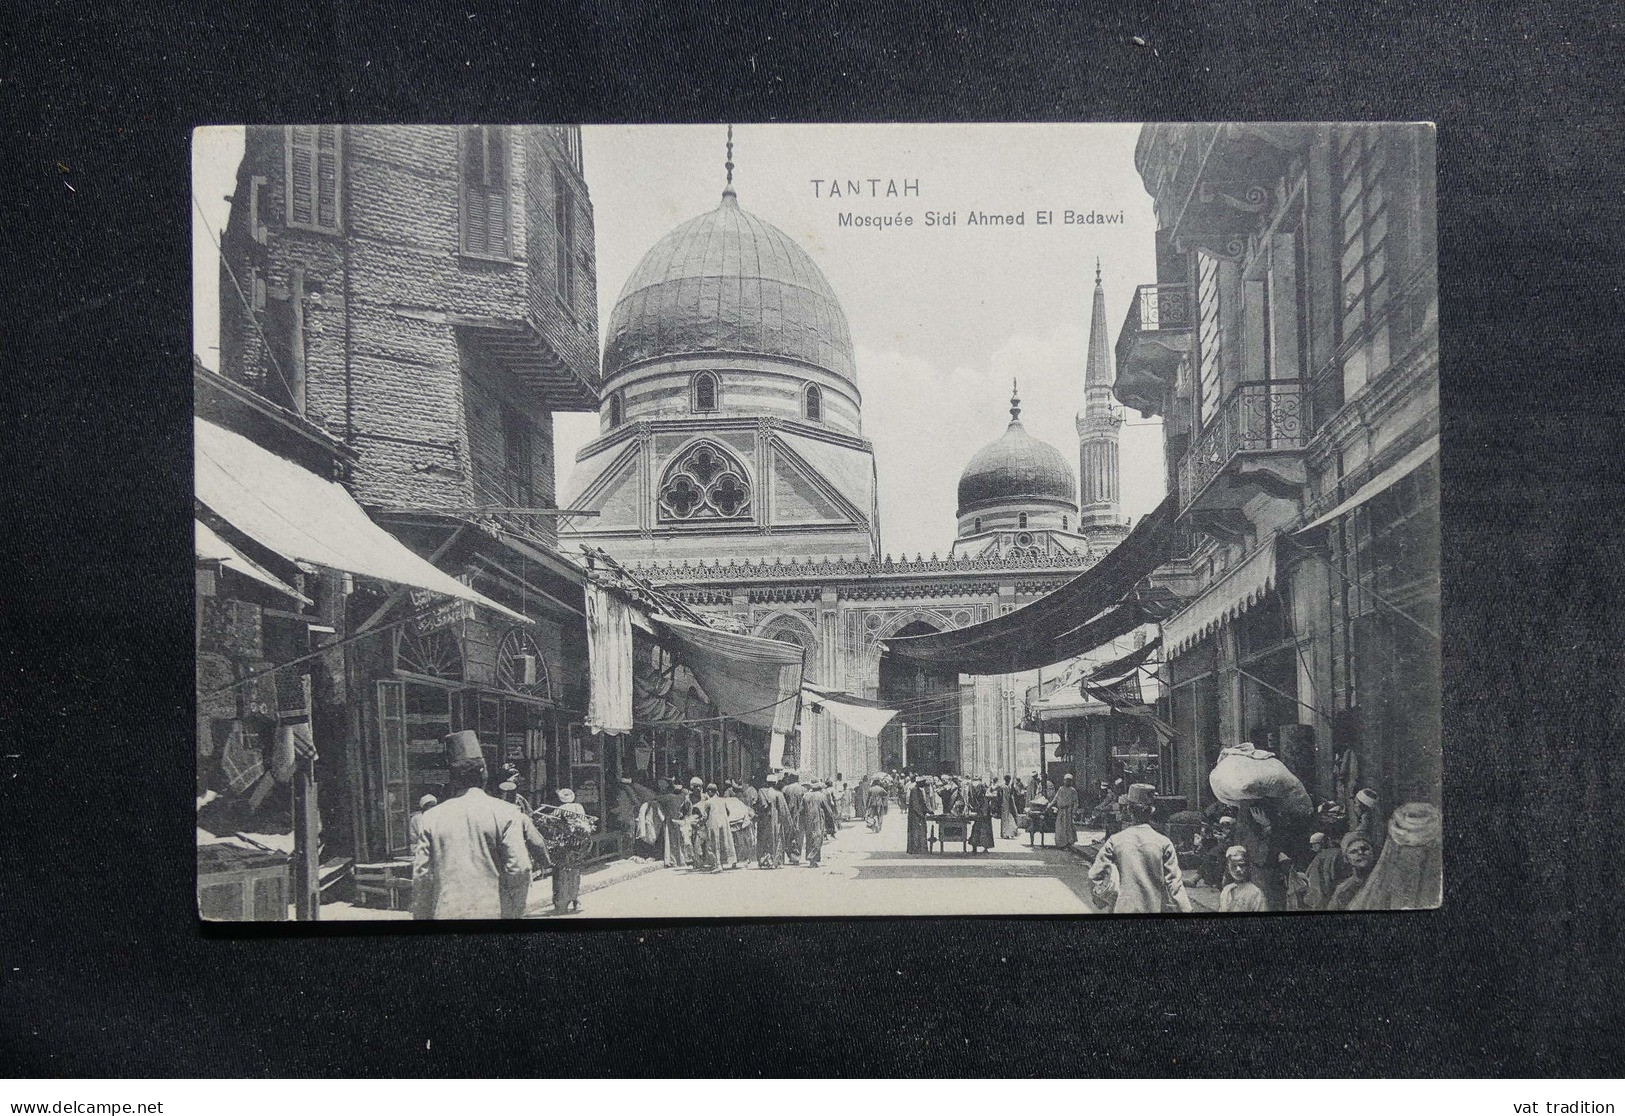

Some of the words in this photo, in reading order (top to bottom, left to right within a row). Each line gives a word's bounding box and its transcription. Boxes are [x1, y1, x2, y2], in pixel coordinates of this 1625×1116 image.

[811, 179, 920, 198] TANTAH
[838, 211, 914, 231] Mosquée
[925, 211, 957, 227] Sidi
[967, 211, 1025, 226] Ahmed
[1036, 210, 1053, 225] El
[1064, 210, 1125, 225] Badawi
